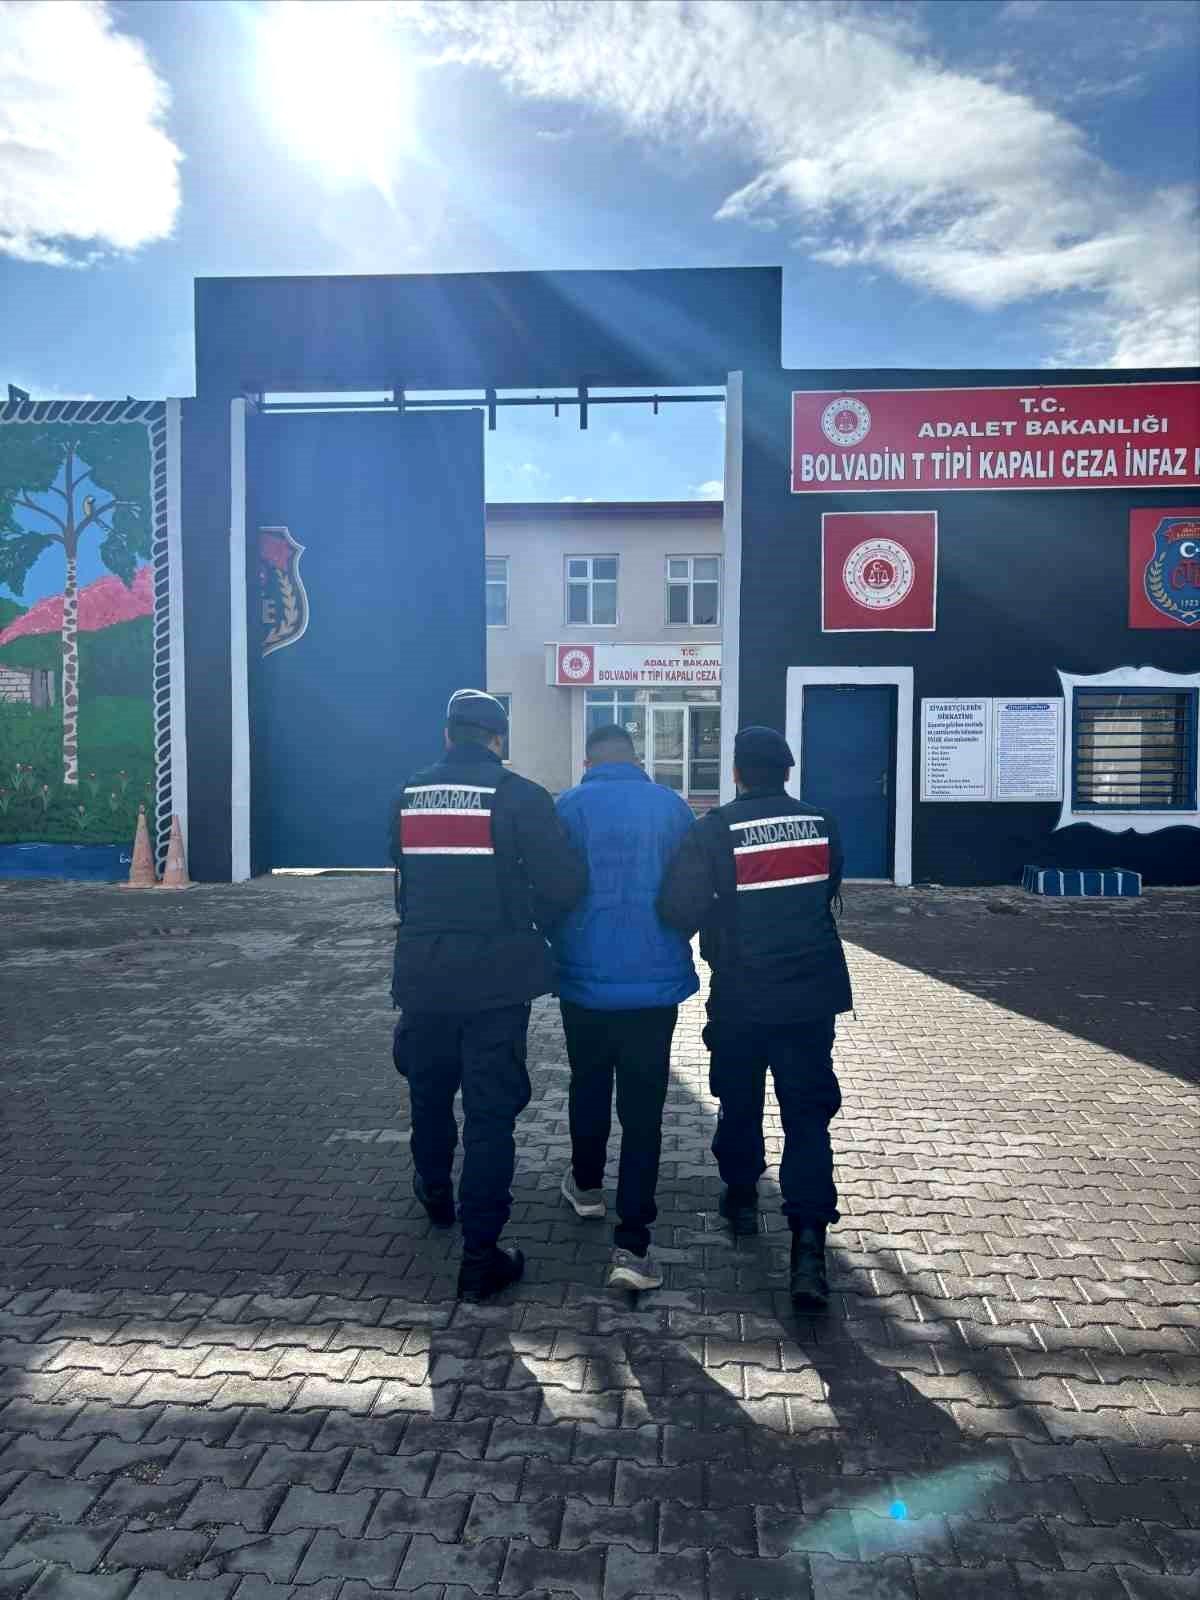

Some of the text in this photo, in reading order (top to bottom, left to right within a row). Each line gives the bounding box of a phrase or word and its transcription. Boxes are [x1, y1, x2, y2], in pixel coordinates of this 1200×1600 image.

[1019, 398, 1065, 413] T.C.
[918, 414, 1168, 438] ADALET BAKANLIĞI
[801, 446, 905, 482] BOLVADİN
[912, 453, 925, 480] T
[931, 445, 971, 480] TİPİ
[979, 450, 1054, 479] KAPALI
[1061, 449, 1118, 478] CEZA
[1125, 441, 1187, 477] İNFAZ
[644, 659, 680, 667] ADALET
[599, 669, 638, 680] BOLVADİN
[640, 670, 645, 681] T
[648, 669, 663, 680] TİPİ
[665, 670, 693, 681] KAPALI
[696, 670, 717, 681] CEZA
[408, 790, 481, 809] JANDARMA
[741, 821, 819, 846] JANDARMA
